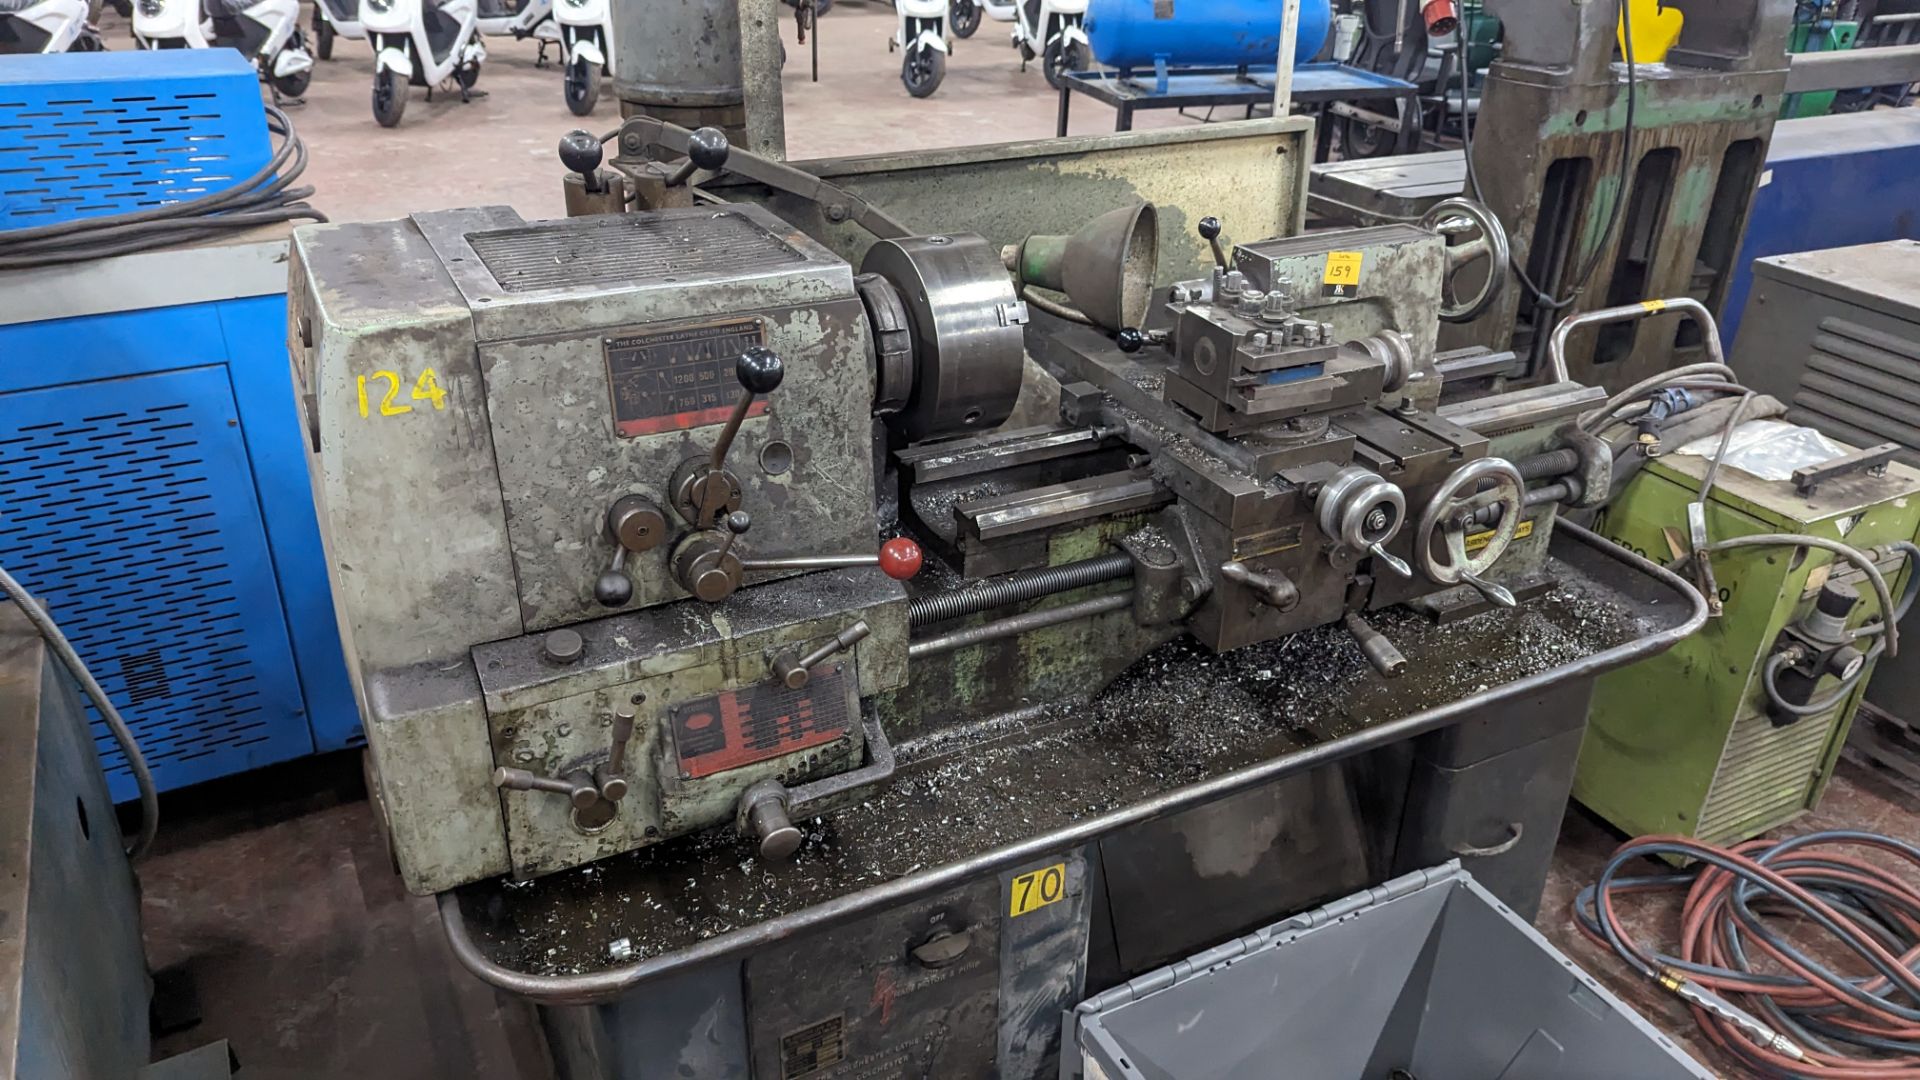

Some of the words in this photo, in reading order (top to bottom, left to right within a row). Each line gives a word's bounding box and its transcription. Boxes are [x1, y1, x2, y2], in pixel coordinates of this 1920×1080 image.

[1330, 266, 1352, 279] 159
[616, 339, 630, 349] THE
[631, 335, 674, 347] COLCHESTER
[721, 324, 754, 336] ENGLAND
[357, 367, 448, 420] 124
[701, 393, 717, 404] 315
[1018, 868, 1061, 912] 70
[930, 912, 945, 924] OFF
